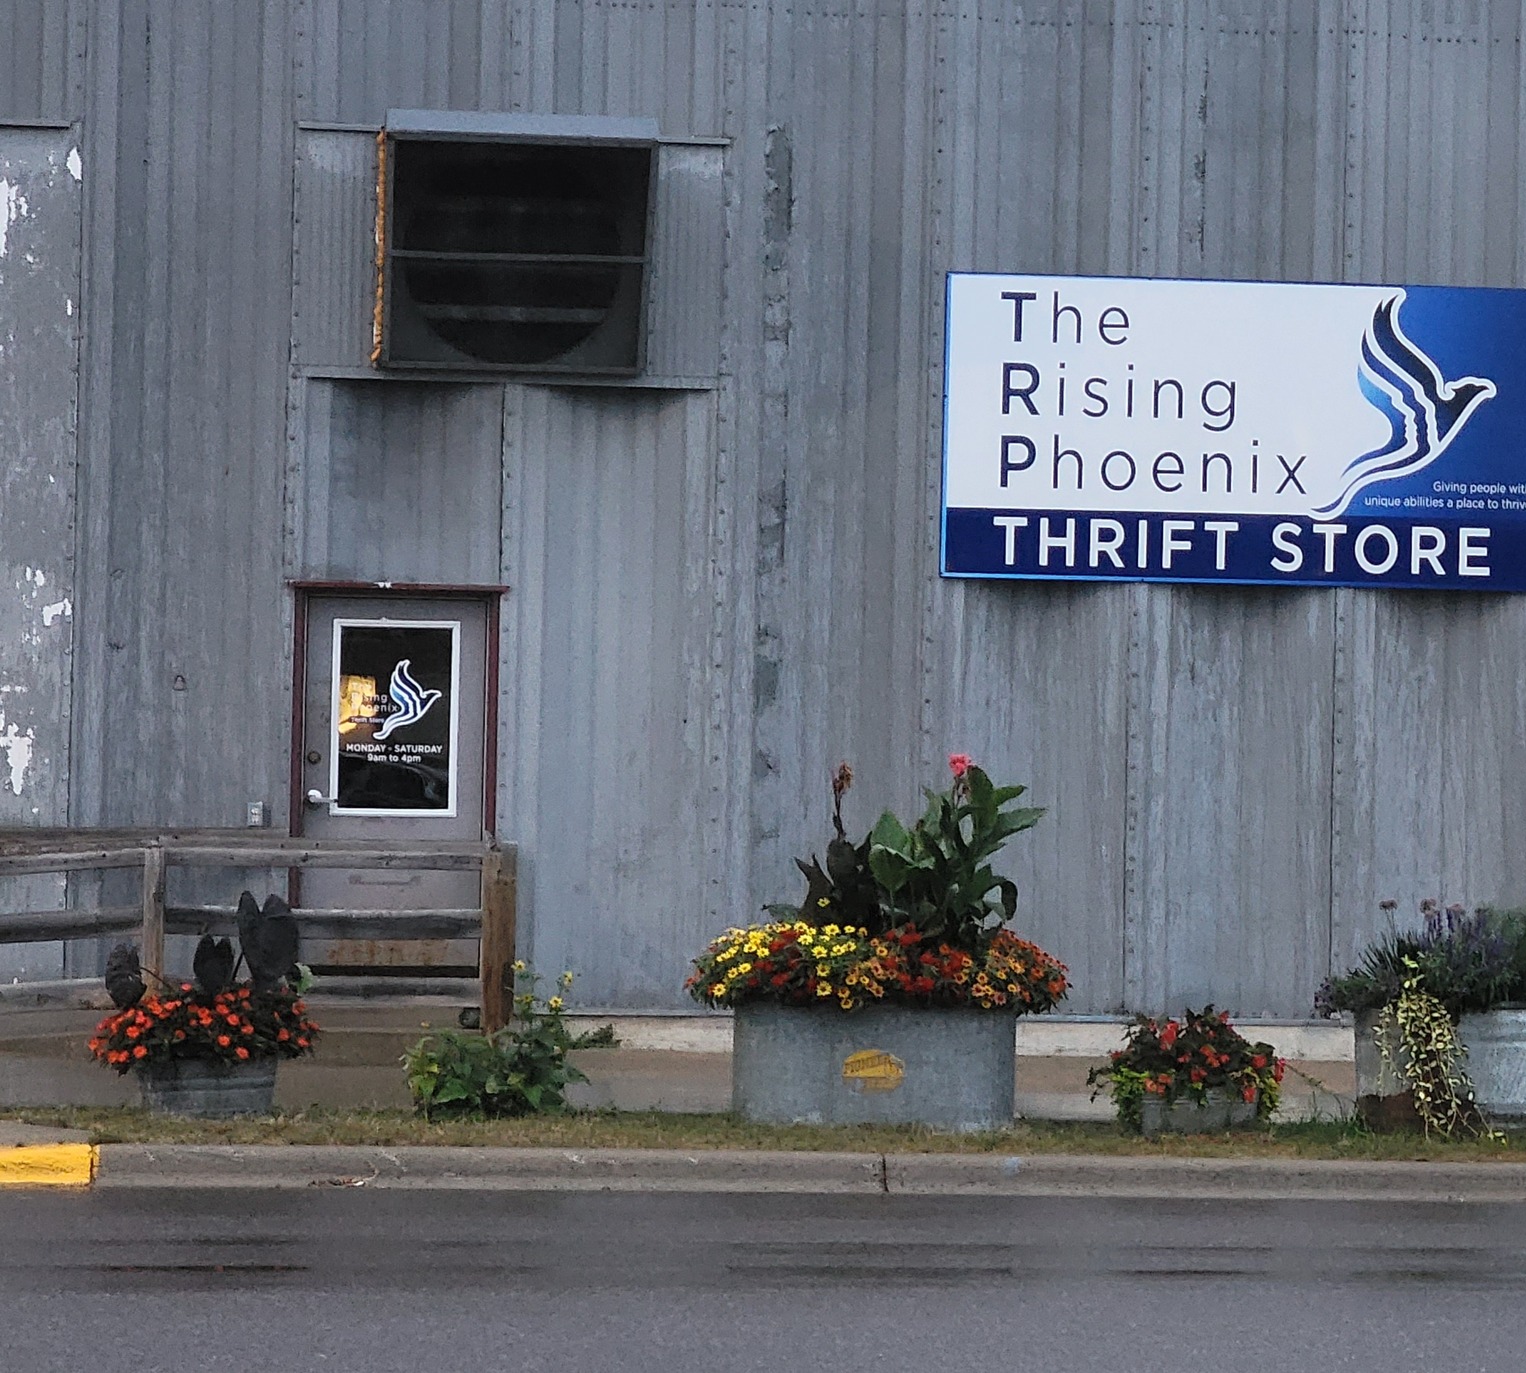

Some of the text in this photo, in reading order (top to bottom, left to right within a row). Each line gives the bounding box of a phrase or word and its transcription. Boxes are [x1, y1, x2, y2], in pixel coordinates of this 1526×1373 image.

[1001, 291, 1130, 346] The
[1000, 361, 1236, 432] Rising
[999, 434, 1307, 495] Phoenix
[1364, 495, 1401, 508] unique
[1403, 496, 1445, 507] abilities
[1447, 499, 1453, 508] a
[1456, 497, 1484, 510] place
[1487, 498, 1499, 509] to
[1433, 481, 1467, 494] Giving
[1470, 482, 1507, 495] people
[993, 516, 1492, 577] THRIFT STORE
[346, 743, 386, 752] MONDAY
[394, 744, 443, 753] SATURDAY
[367, 753, 422, 763] 9am to 4pm
